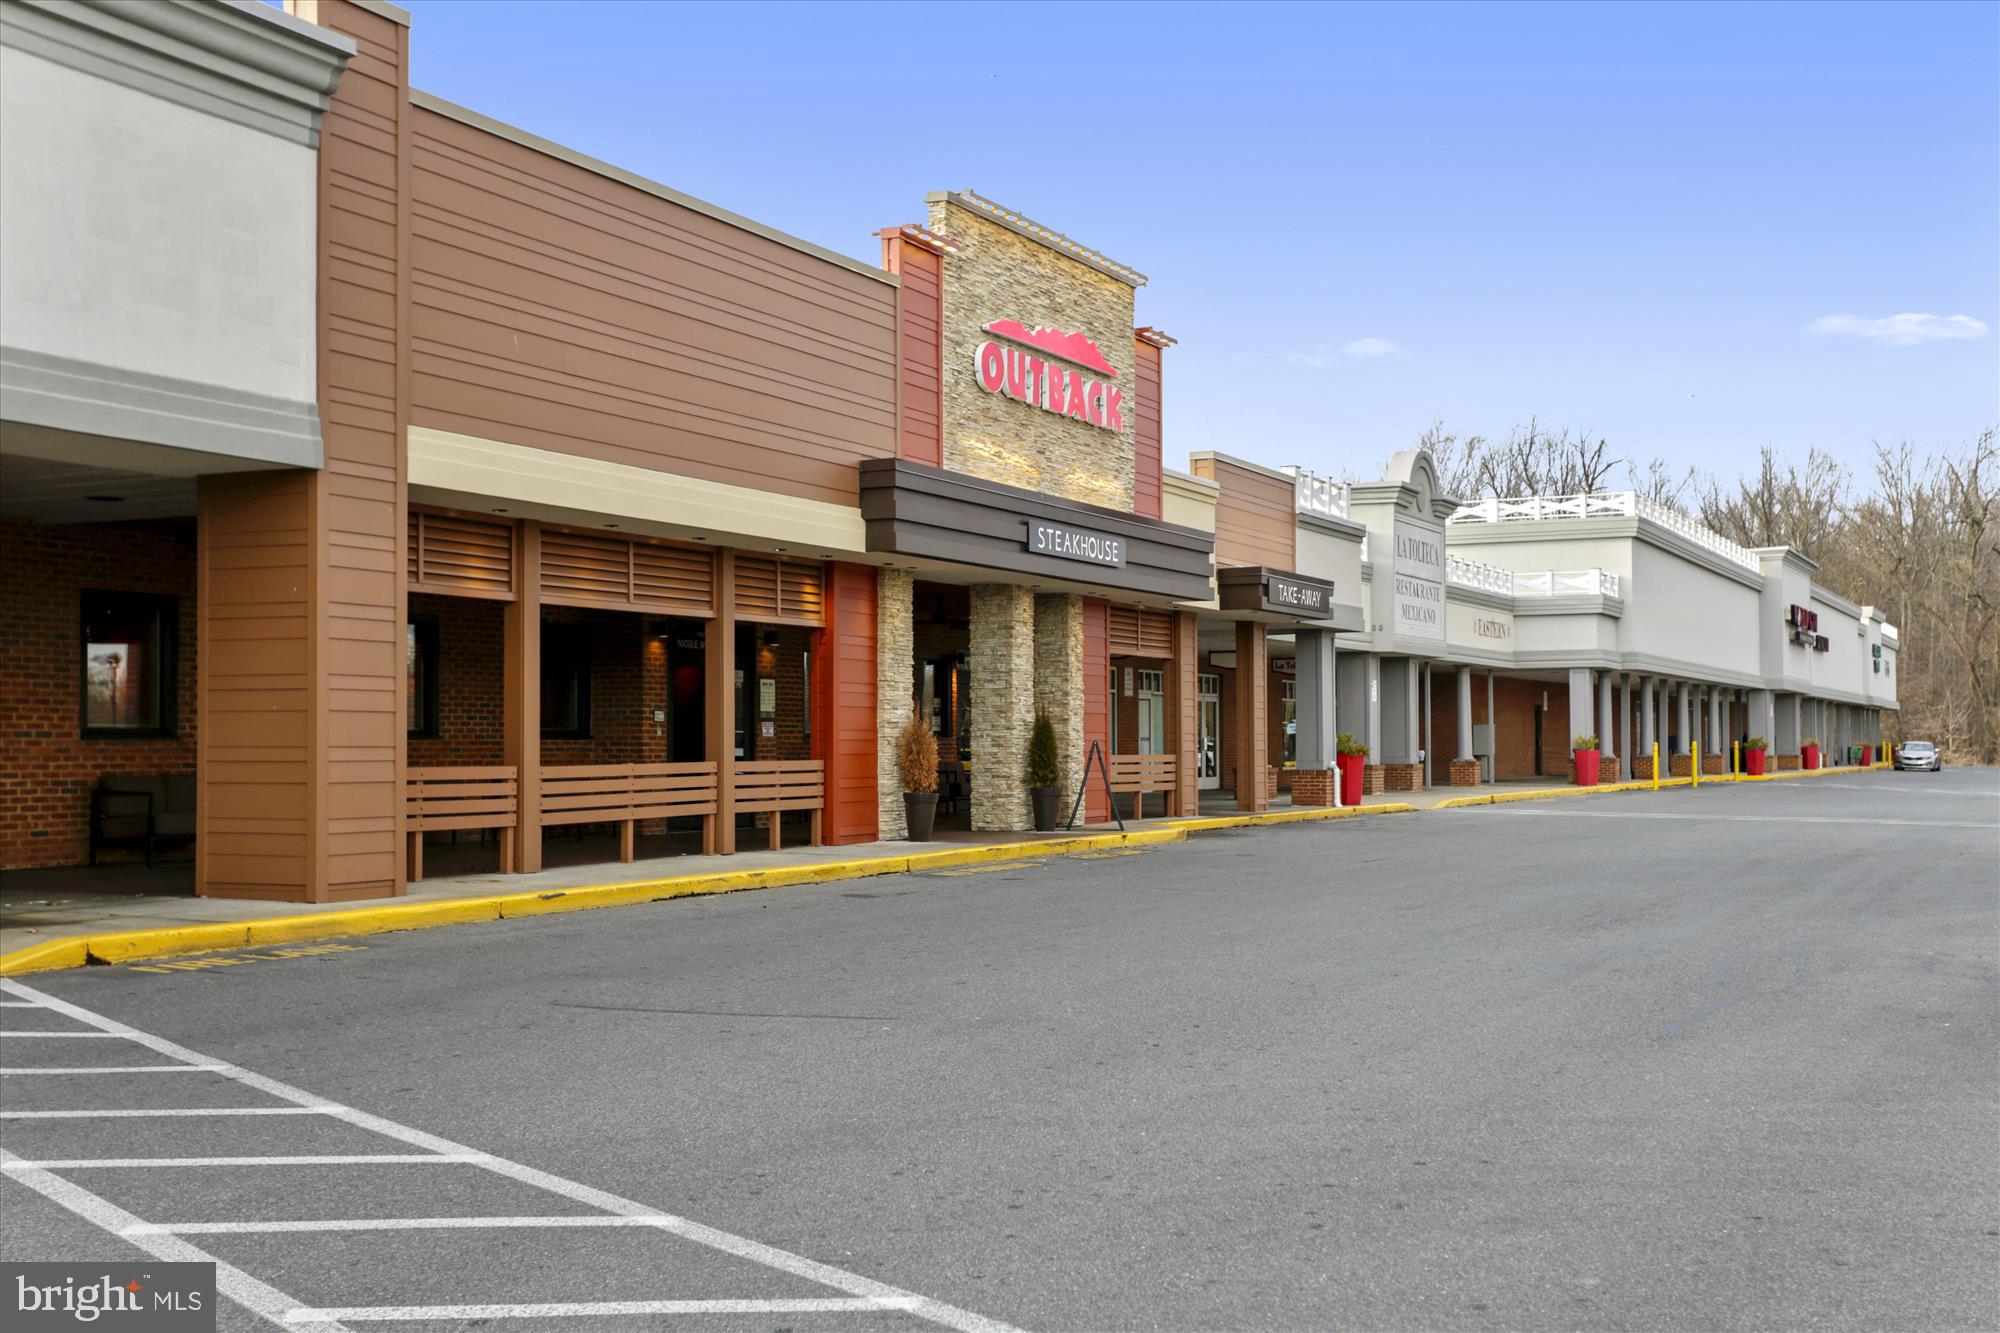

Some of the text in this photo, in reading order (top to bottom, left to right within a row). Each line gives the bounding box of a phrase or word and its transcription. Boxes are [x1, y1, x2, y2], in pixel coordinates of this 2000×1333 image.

[974, 341, 1123, 433] OUTBACK
[1037, 527, 1119, 562] STEAKHOUSE
[1397, 535, 1440, 567] LA TOLTECA
[1278, 584, 1321, 607] TAKE-AWAY
[1395, 578, 1440, 602] RESTAURANTE
[1401, 603, 1436, 624] MEXICANO
[1478, 618, 1506, 639] EASTERN
